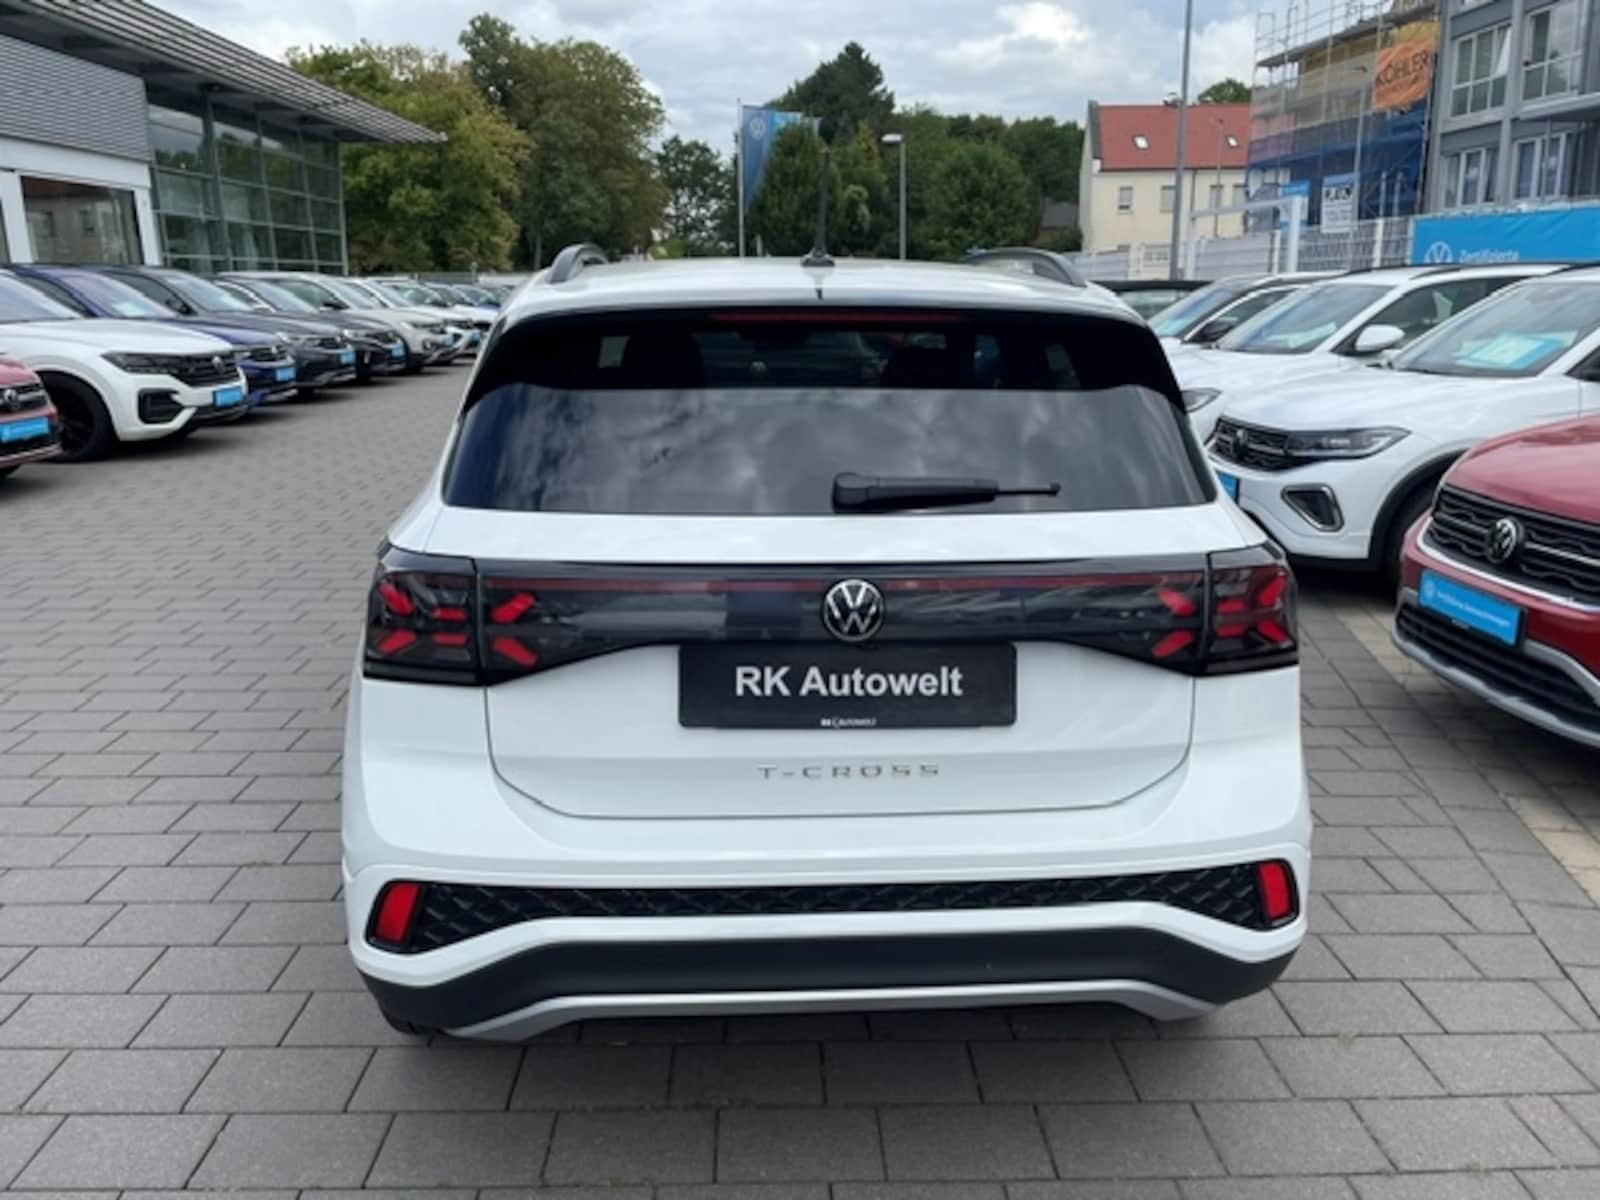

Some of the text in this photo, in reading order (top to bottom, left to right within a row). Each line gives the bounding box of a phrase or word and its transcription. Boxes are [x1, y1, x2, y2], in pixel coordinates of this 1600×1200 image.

[735, 666, 963, 697] RK Autowelt
[757, 763, 939, 779] T-CROSS
